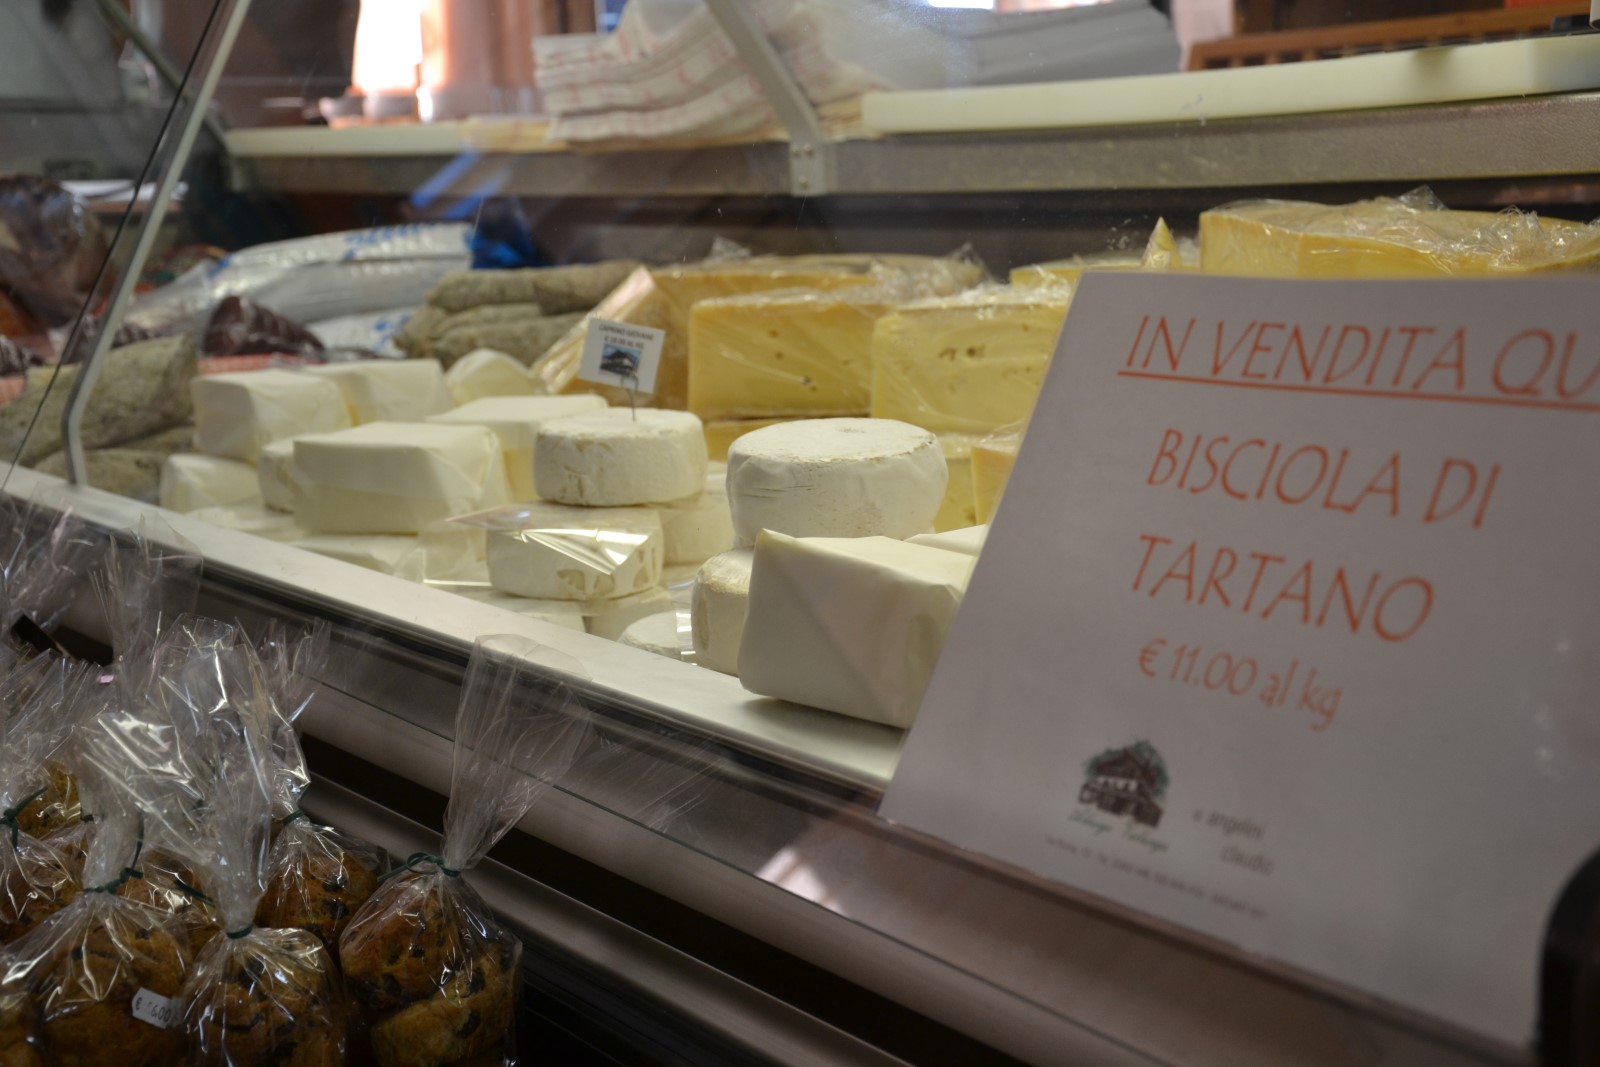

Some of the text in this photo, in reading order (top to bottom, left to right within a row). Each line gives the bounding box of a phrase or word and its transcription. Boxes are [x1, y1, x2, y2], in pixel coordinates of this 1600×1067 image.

[1126, 314, 1196, 372] IN
[1211, 319, 1467, 391] VENDITA
[1146, 428, 1501, 528] BISCIOLA DI
[1132, 533, 1434, 642] TARTANO
[1138, 637, 1343, 733] € 11.00 al kg
